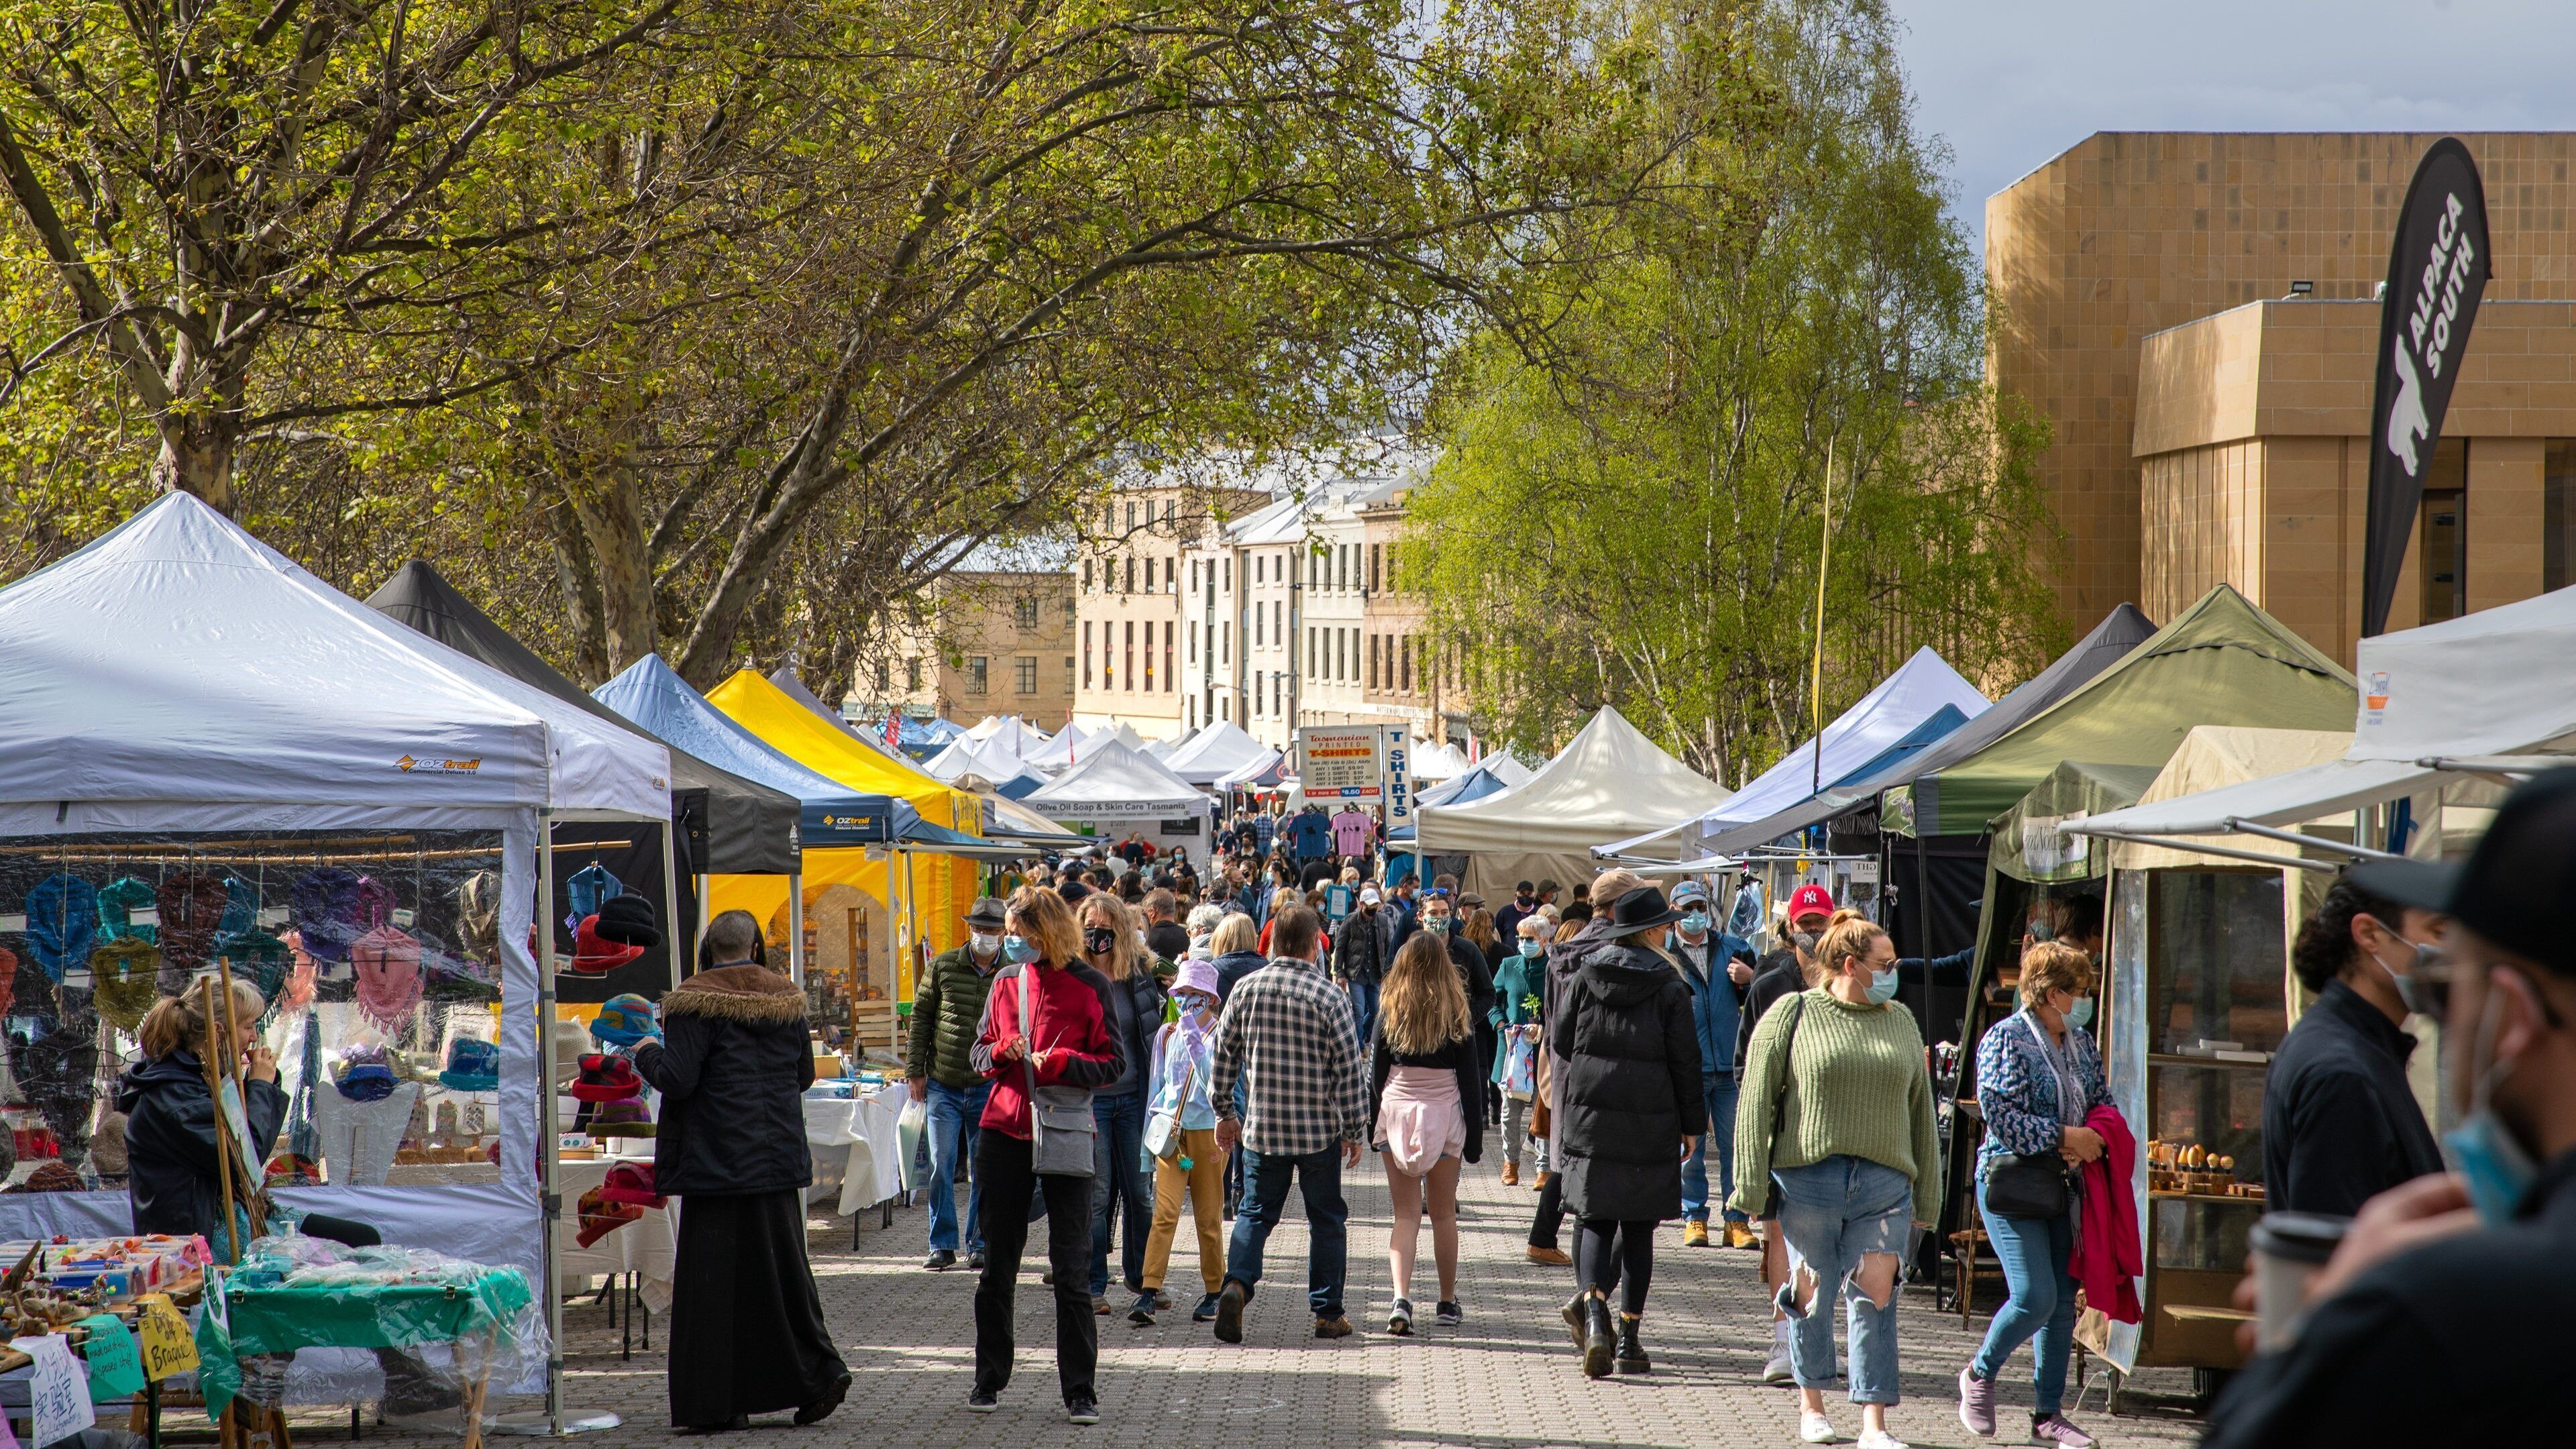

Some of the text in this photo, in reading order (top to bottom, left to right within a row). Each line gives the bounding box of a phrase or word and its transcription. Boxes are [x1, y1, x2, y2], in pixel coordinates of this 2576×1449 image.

[2410, 192, 2463, 355] ALPACA
[2426, 232, 2475, 379] SOUTH
[1309, 748, 1372, 757] T-SHIRTS
[419, 759, 481, 769] OZtrail
[1036, 803, 1057, 811] Olive
[1059, 803, 1071, 811] Oil
[1073, 803, 1094, 812] Soap
[1146, 802, 1186, 810] Tasmania
